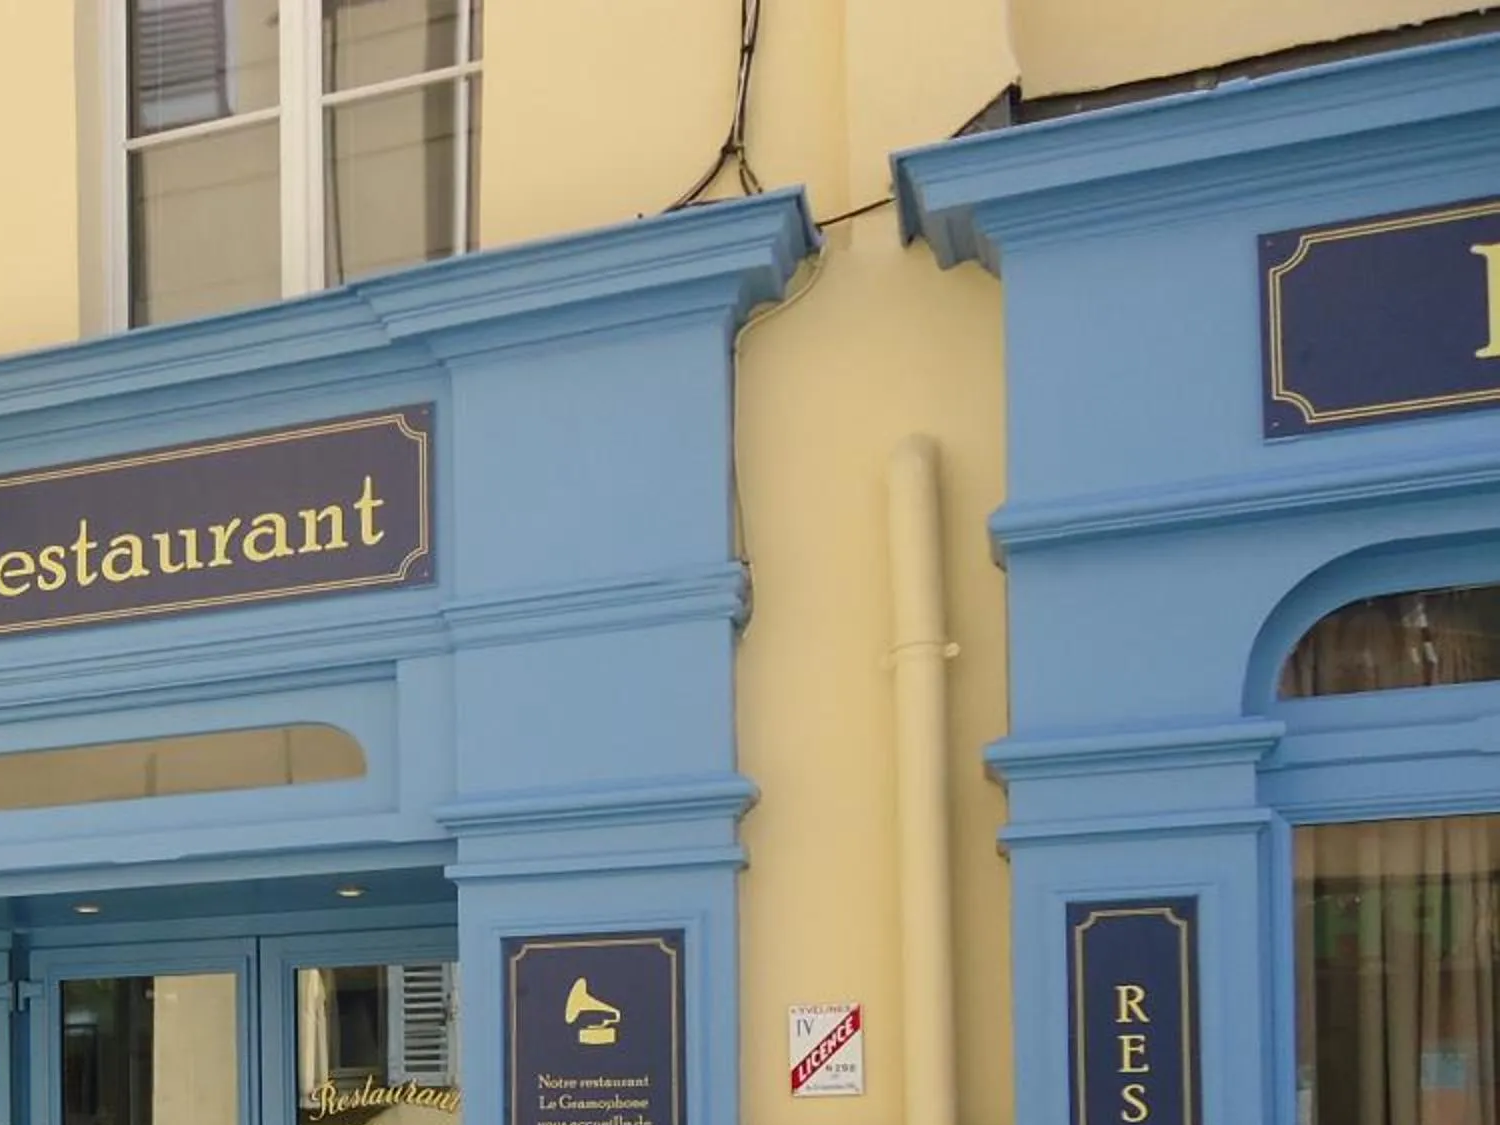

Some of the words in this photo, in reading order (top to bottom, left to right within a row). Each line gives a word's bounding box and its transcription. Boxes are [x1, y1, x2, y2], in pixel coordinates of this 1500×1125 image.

[797, 1018, 814, 1036] IV
[798, 1015, 854, 1082] LICENCE
[538, 1074, 577, 1088] Notre
[580, 1076, 650, 1088] restaurant
[539, 1096, 557, 1110] Le
[559, 1094, 649, 1113] Gramophone
